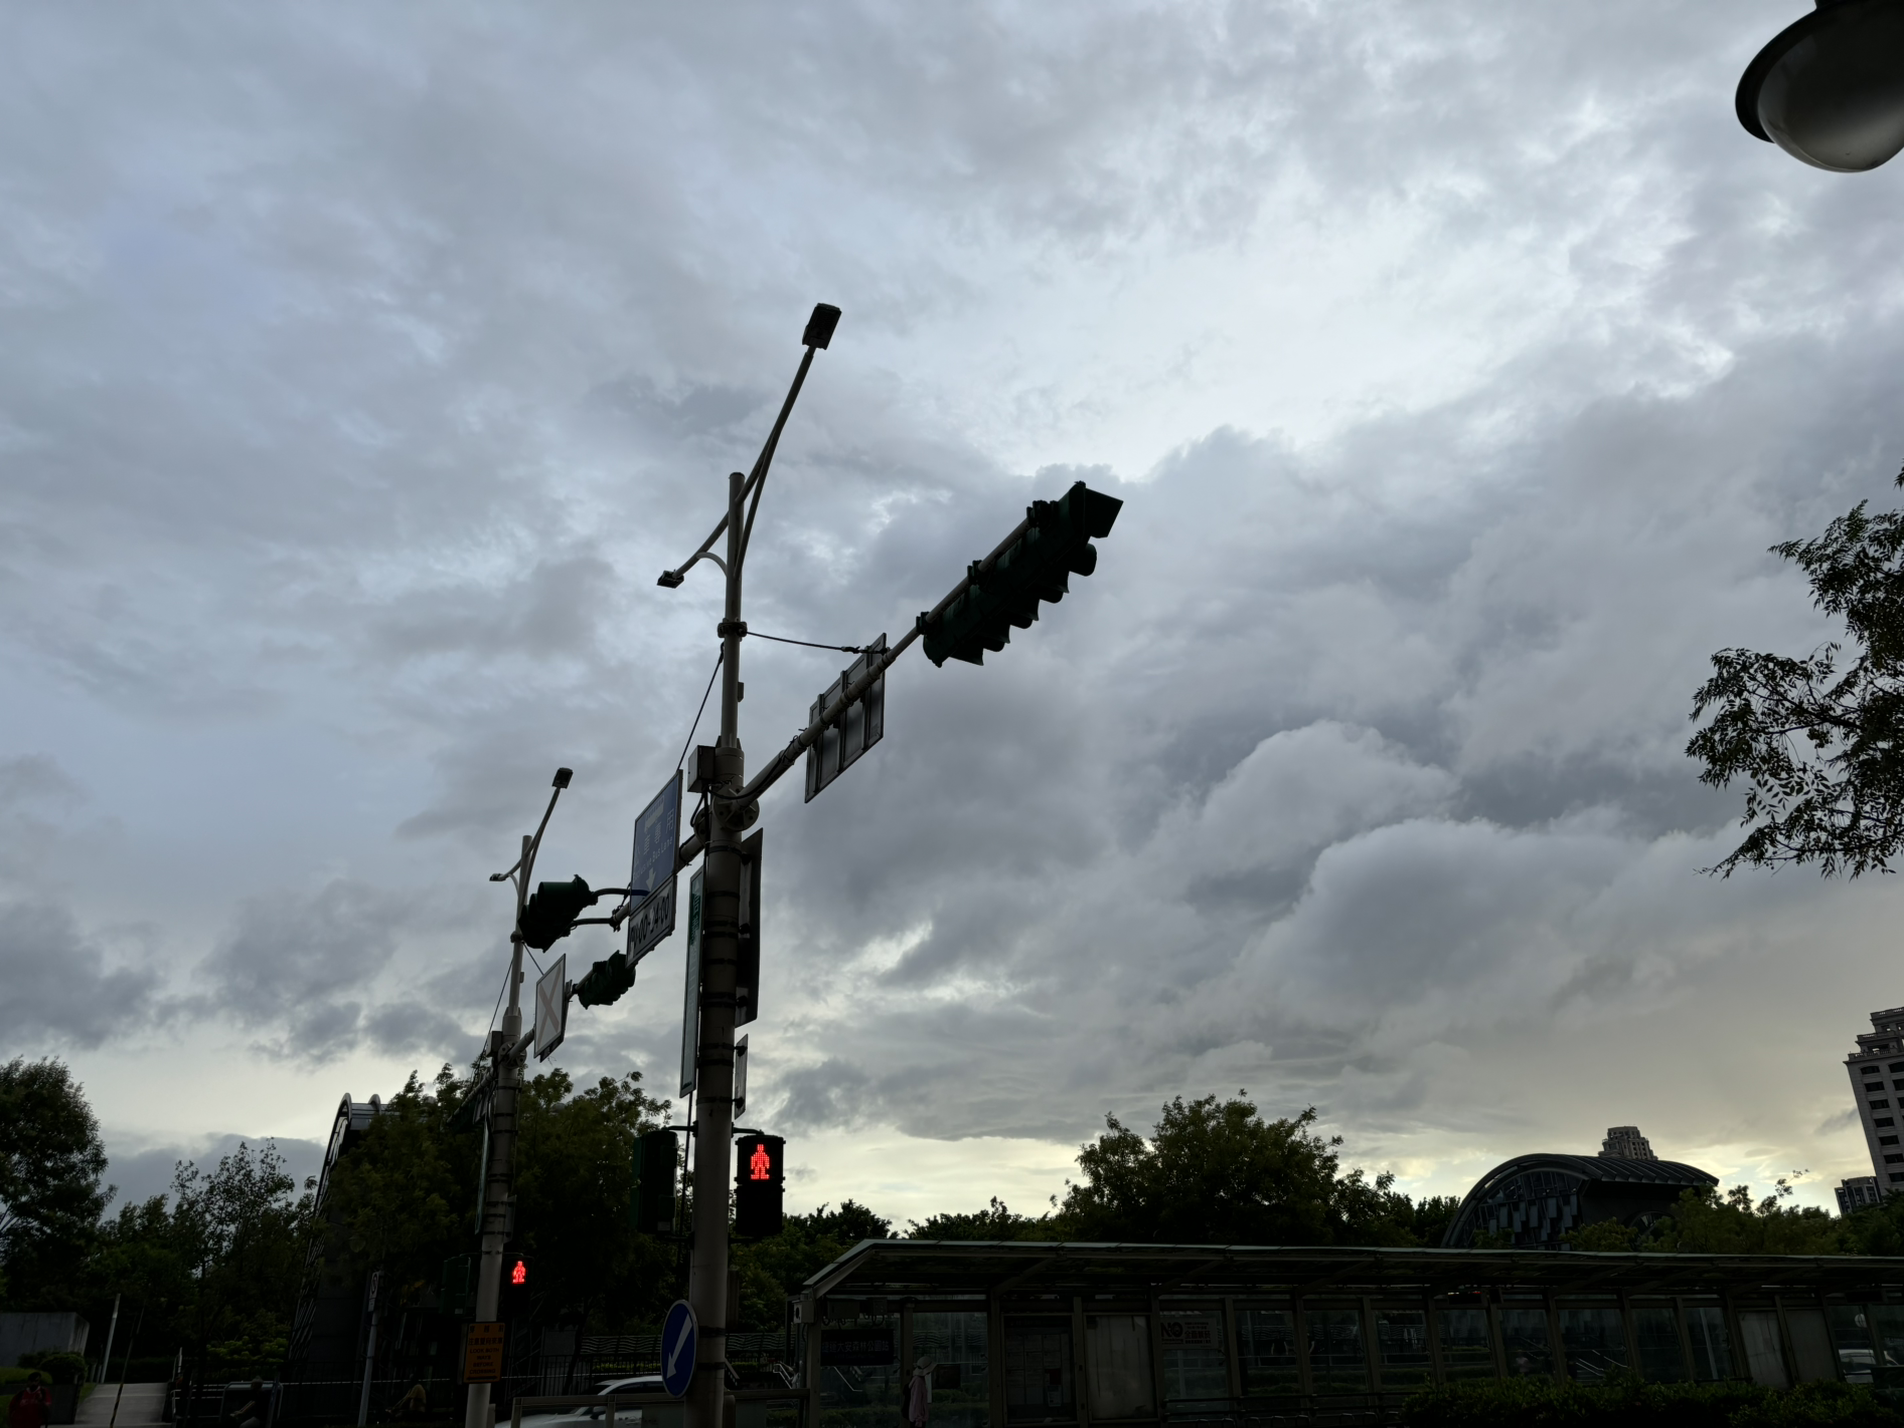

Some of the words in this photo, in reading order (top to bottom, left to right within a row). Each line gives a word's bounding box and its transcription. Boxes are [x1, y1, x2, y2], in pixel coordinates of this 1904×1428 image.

[652, 848, 661, 864] Bus
[660, 836, 673, 854] Lane
[1160, 1322, 1183, 1338] NO
